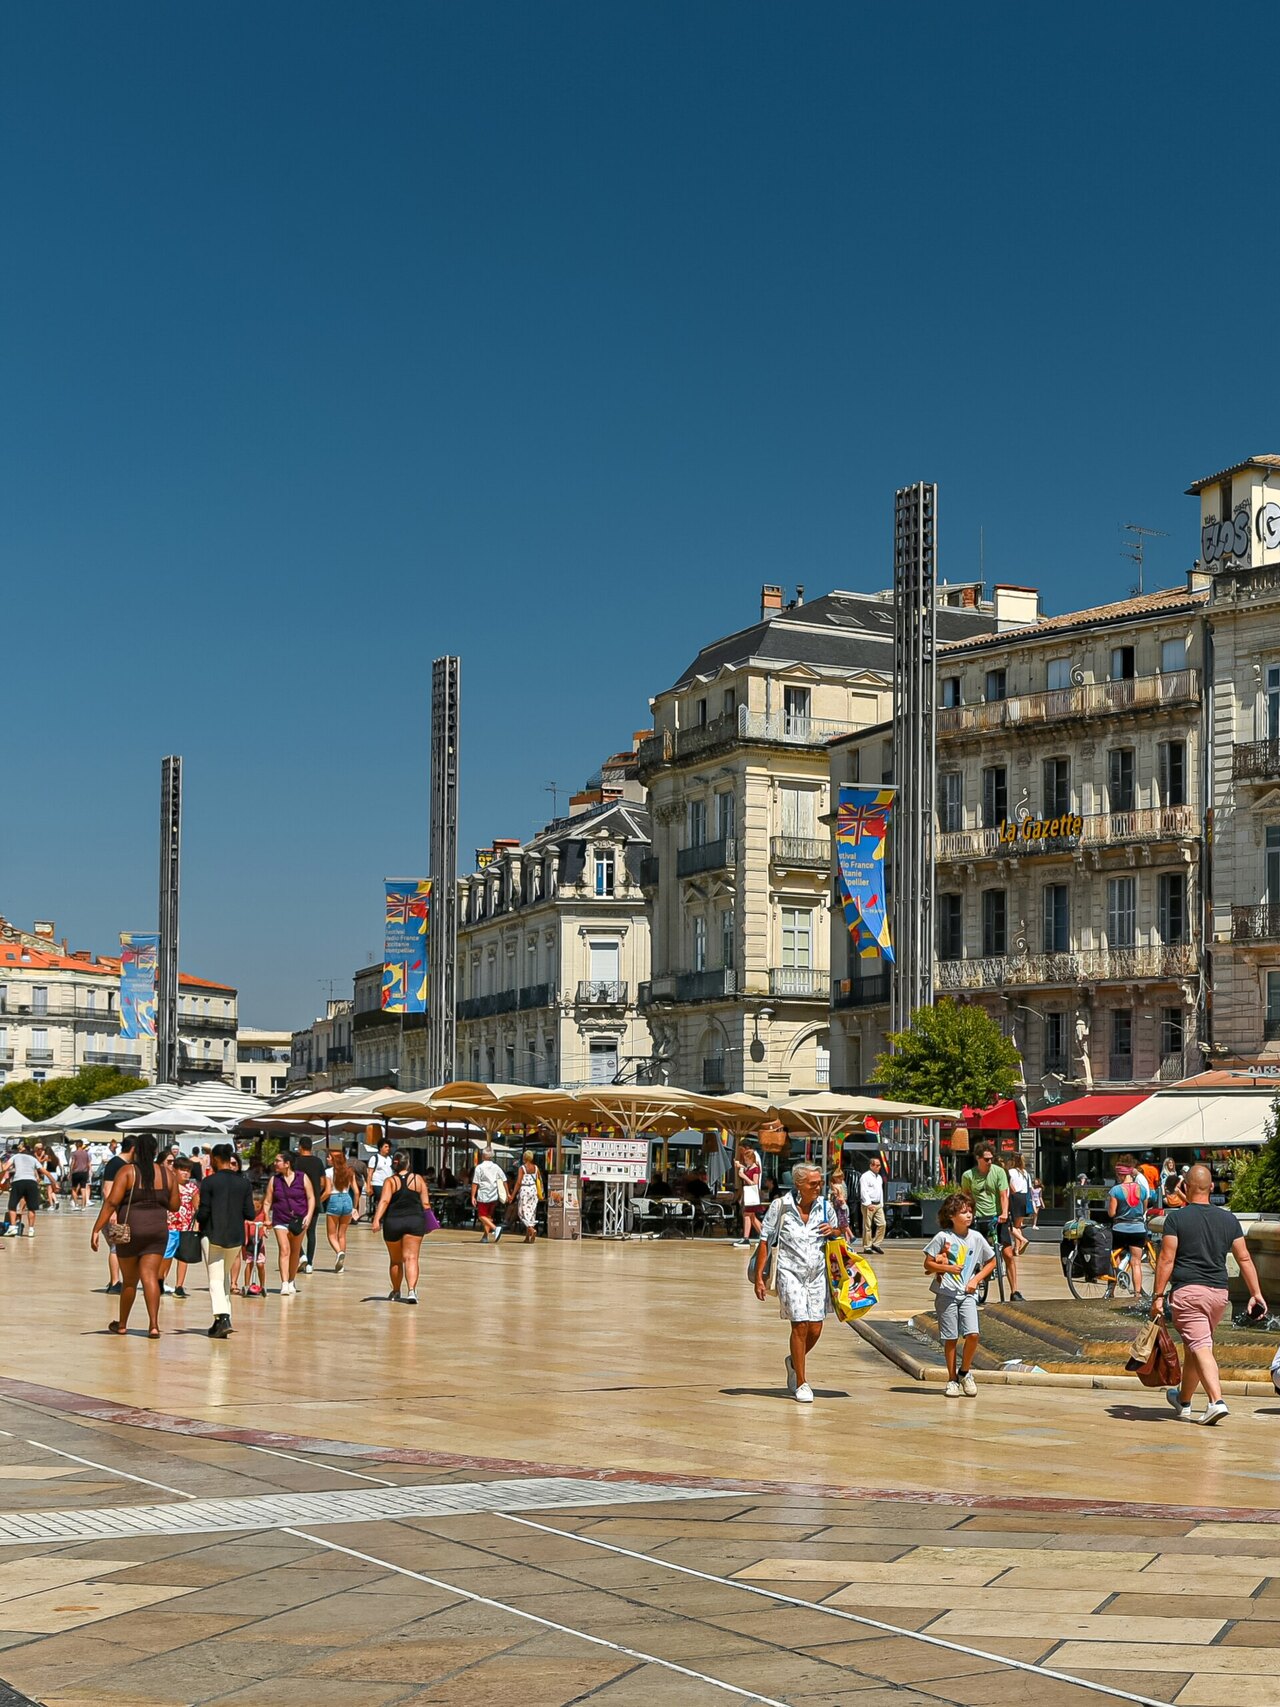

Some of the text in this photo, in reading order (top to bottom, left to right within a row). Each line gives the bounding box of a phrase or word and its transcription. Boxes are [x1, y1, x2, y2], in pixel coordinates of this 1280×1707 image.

[1000, 813, 1083, 843] La Gazette
[851, 861, 875, 869] France
